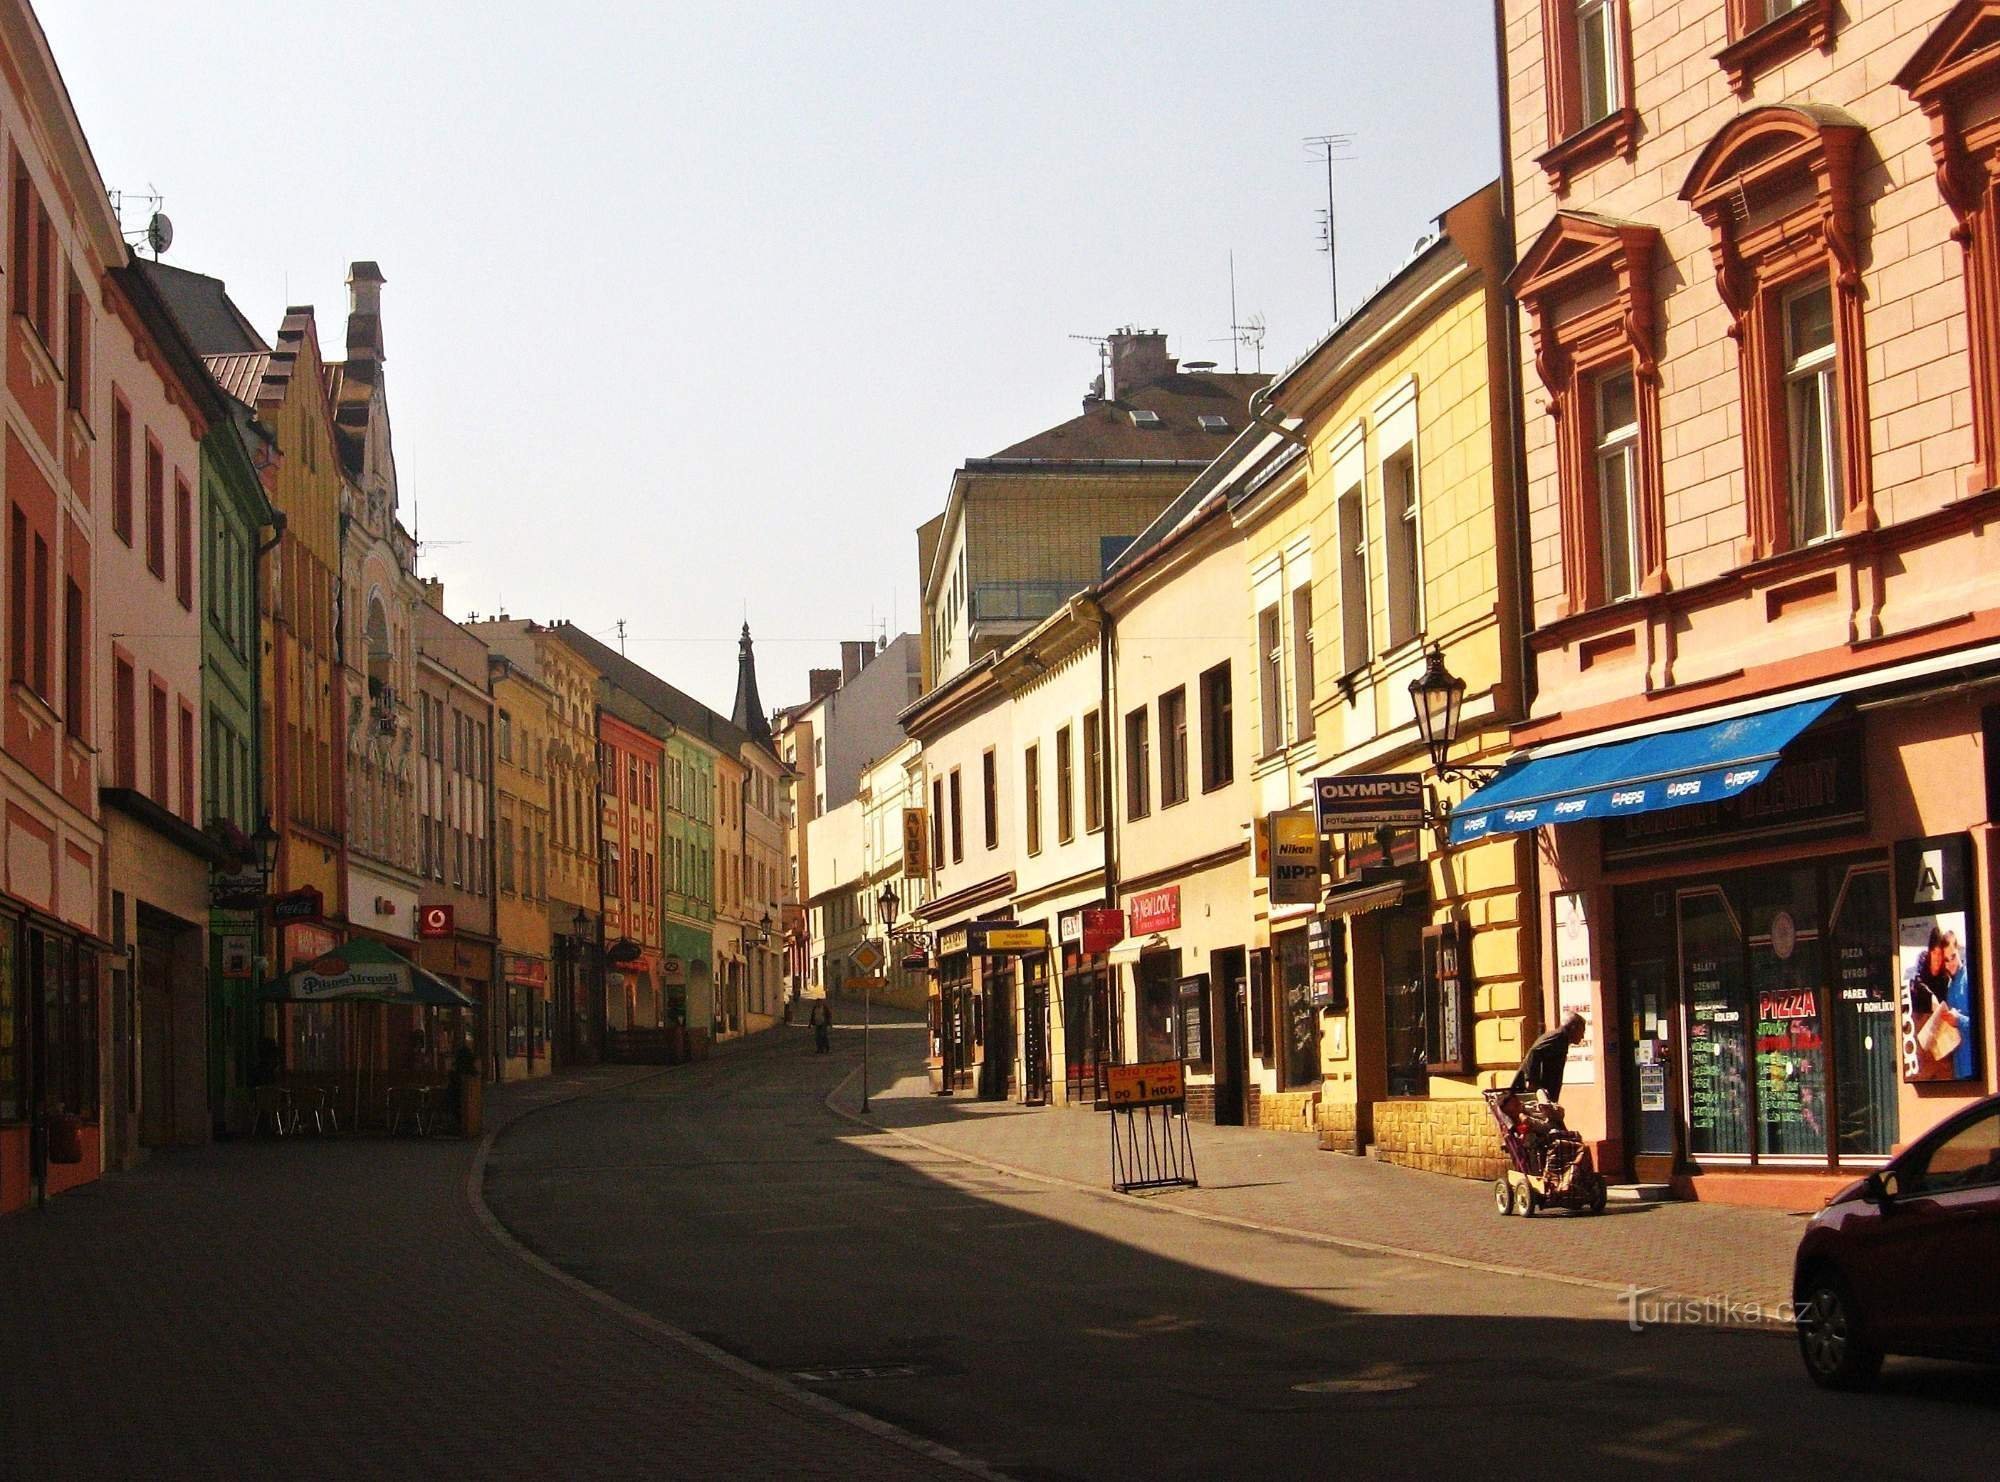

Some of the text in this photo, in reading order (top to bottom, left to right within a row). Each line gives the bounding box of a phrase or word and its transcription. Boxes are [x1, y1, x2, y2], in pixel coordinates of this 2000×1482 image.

[1731, 770, 1760, 786] PEPSI
[1321, 781, 1421, 799] OLYMPUS
[1673, 781, 1702, 797] PEPSI
[1618, 790, 1646, 806] PEPSI
[1560, 799, 1588, 814] PEPSI
[1467, 816, 1488, 831] PEPSI
[1511, 809, 1538, 823] PEPSI
[1278, 844, 1313, 856] Nikon
[1276, 864, 1318, 880] NPP
[1919, 867, 1941, 893] A
[1843, 987, 1868, 1000] PÁREK
[1760, 988, 1816, 1020] PIZZA
[1856, 1003, 1863, 1013] V
[1114, 1089, 1130, 1099] DO
[1136, 1080, 1146, 1098] 1
